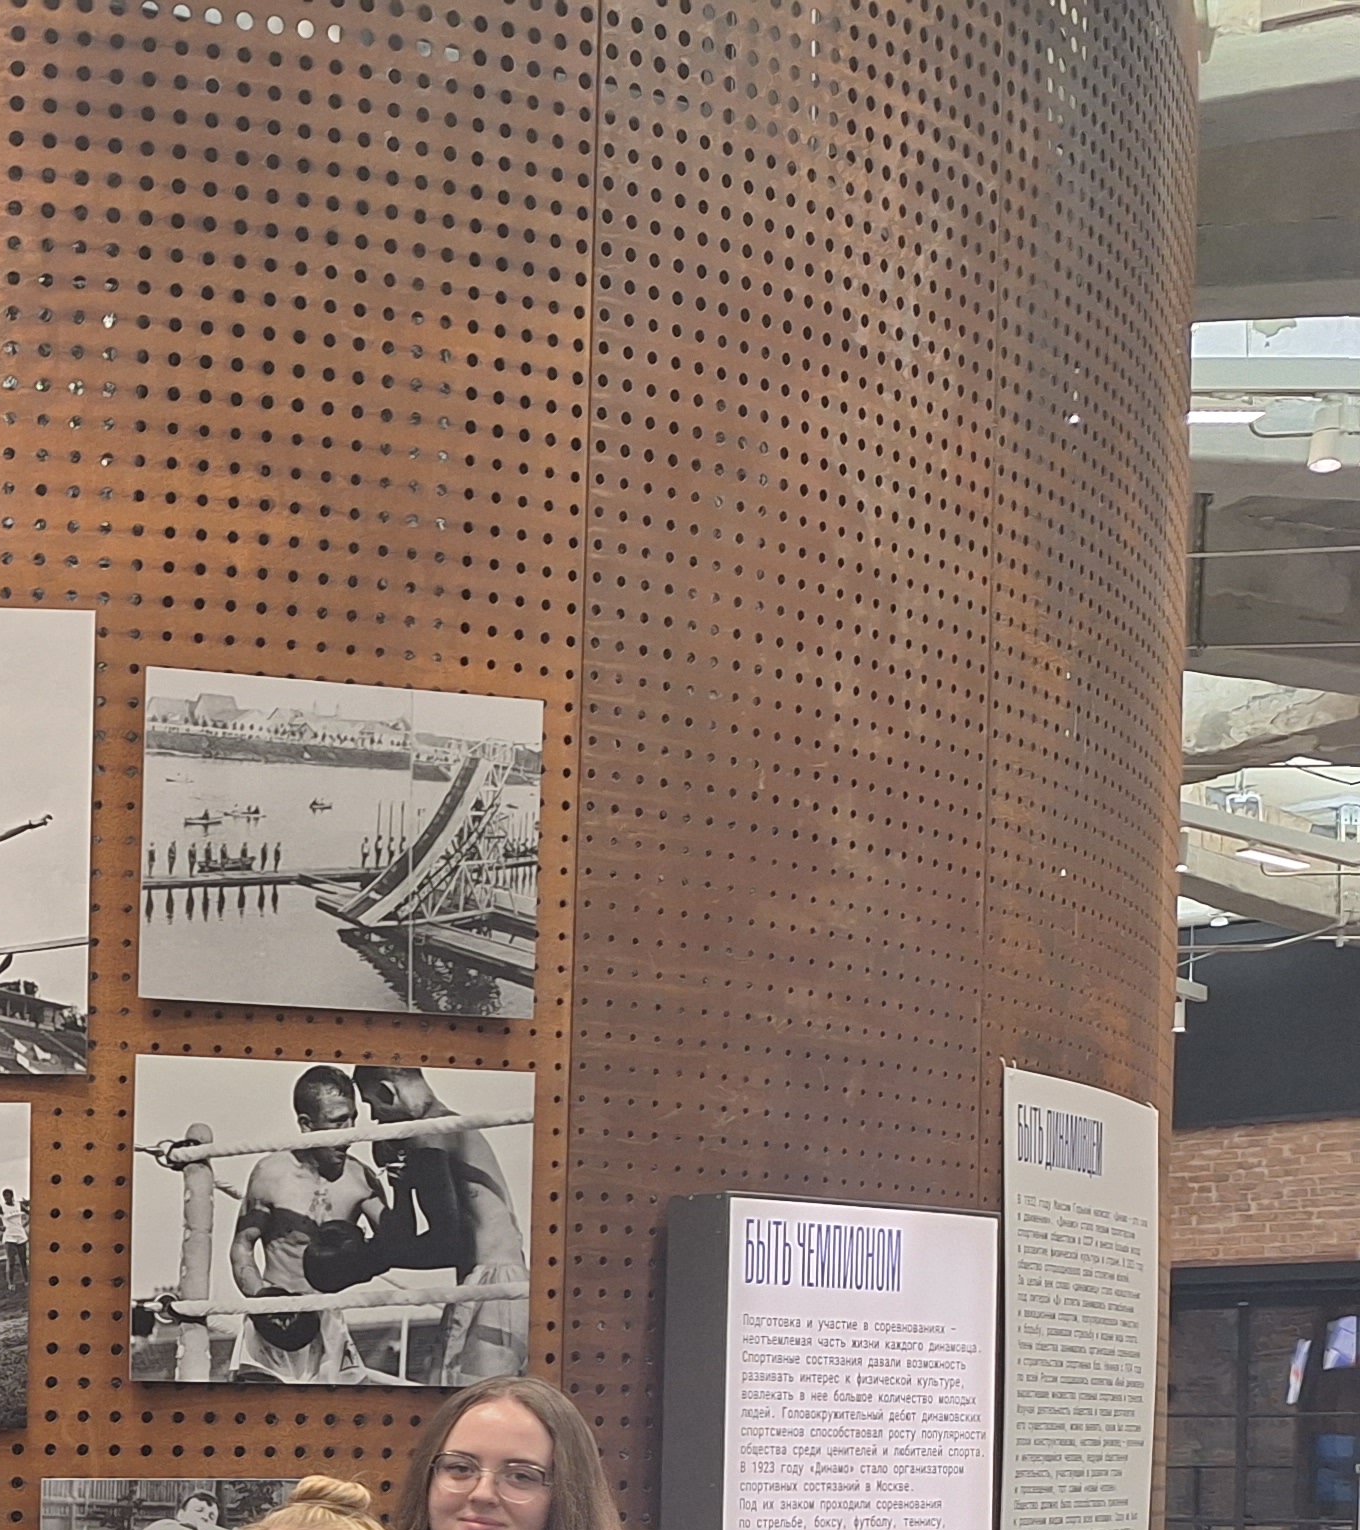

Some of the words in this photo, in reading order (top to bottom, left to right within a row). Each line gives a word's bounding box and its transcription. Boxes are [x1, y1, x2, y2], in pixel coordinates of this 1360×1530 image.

[1017, 1104, 1044, 1165] БЫТЬ
[1045, 1110, 1104, 1178] ДИНАМОВЦЕМ
[744, 1218, 792, 1286] БЫТЬ
[796, 1222, 902, 1292] ЧЕМПИОНОМ
[743, 1314, 801, 1328] Подготовка
[807, 1320, 812, 1328] и
[818, 1320, 857, 1332] участие
[864, 1322, 868, 1331] в
[875, 1322, 945, 1334] соревнованиях
[742, 1335, 812, 1346] неотъемлемая
[818, 1338, 846, 1348] часть
[851, 1340, 879, 1349] жизни
[885, 1341, 923, 1352] каждого
[928, 1343, 981, 1354] динамовца.
[742, 1351, 800, 1365] Спортивные
[806, 1356, 862, 1366] состязания
[868, 1358, 901, 1368] давали
[907, 1359, 966, 1370] возможность
[741, 1372, 794, 1384] развивать
[800, 1374, 839, 1386] интерес
[845, 1375, 850, 1384] к
[857, 1372, 911, 1387] физической
[917, 1377, 964, 1390] культуре,
[741, 1390, 794, 1400] вовлекать
[800, 1392, 805, 1401] в
[811, 1392, 828, 1401] нее
[834, 1389, 872, 1403] большое
[878, 1394, 933, 1404] количество
[939, 1396, 976, 1406] молодых
[741, 1406, 775, 1419] людей.
[782, 1406, 883, 1423] Головокружительный
[889, 1409, 916, 1423] дебют
[921, 1413, 981, 1424] динамовских
[740, 1427, 804, 1439] спортсменов
[810, 1426, 883, 1438] способствовал
[889, 1429, 916, 1442] росту
[922, 1430, 986, 1442] популярности
[740, 1442, 787, 1456] общества
[793, 1446, 821, 1458] среди
[827, 1445, 877, 1458] ценителей
[883, 1447, 888, 1456] и
[894, 1444, 943, 1457] любителей
[948, 1448, 984, 1459] спорта.
[740, 1461, 746, 1473] В
[752, 1461, 775, 1473] 1923
[781, 1464, 804, 1476] году
[810, 1462, 854, 1476] «Динамо»
[860, 1465, 888, 1474] стало
[893, 1465, 964, 1477] организатором
[740, 1482, 797, 1494] спортивных
[803, 1480, 860, 1492] состязаний
[865, 1483, 871, 1492] в
[876, 1480, 914, 1492] Москве.
[740, 1498, 757, 1512] Под
[763, 1501, 774, 1509] их
[780, 1500, 814, 1510] знаком
[820, 1500, 871, 1512] проходили
[876, 1500, 942, 1512] соревнования
[739, 1519, 750, 1528] по
[757, 1516, 806, 1530] стрельбе,
[814, 1515, 846, 1530] боксу,
[854, 1515, 896, 1530] футболу,
[904, 1518, 945, 1529] теннису,
